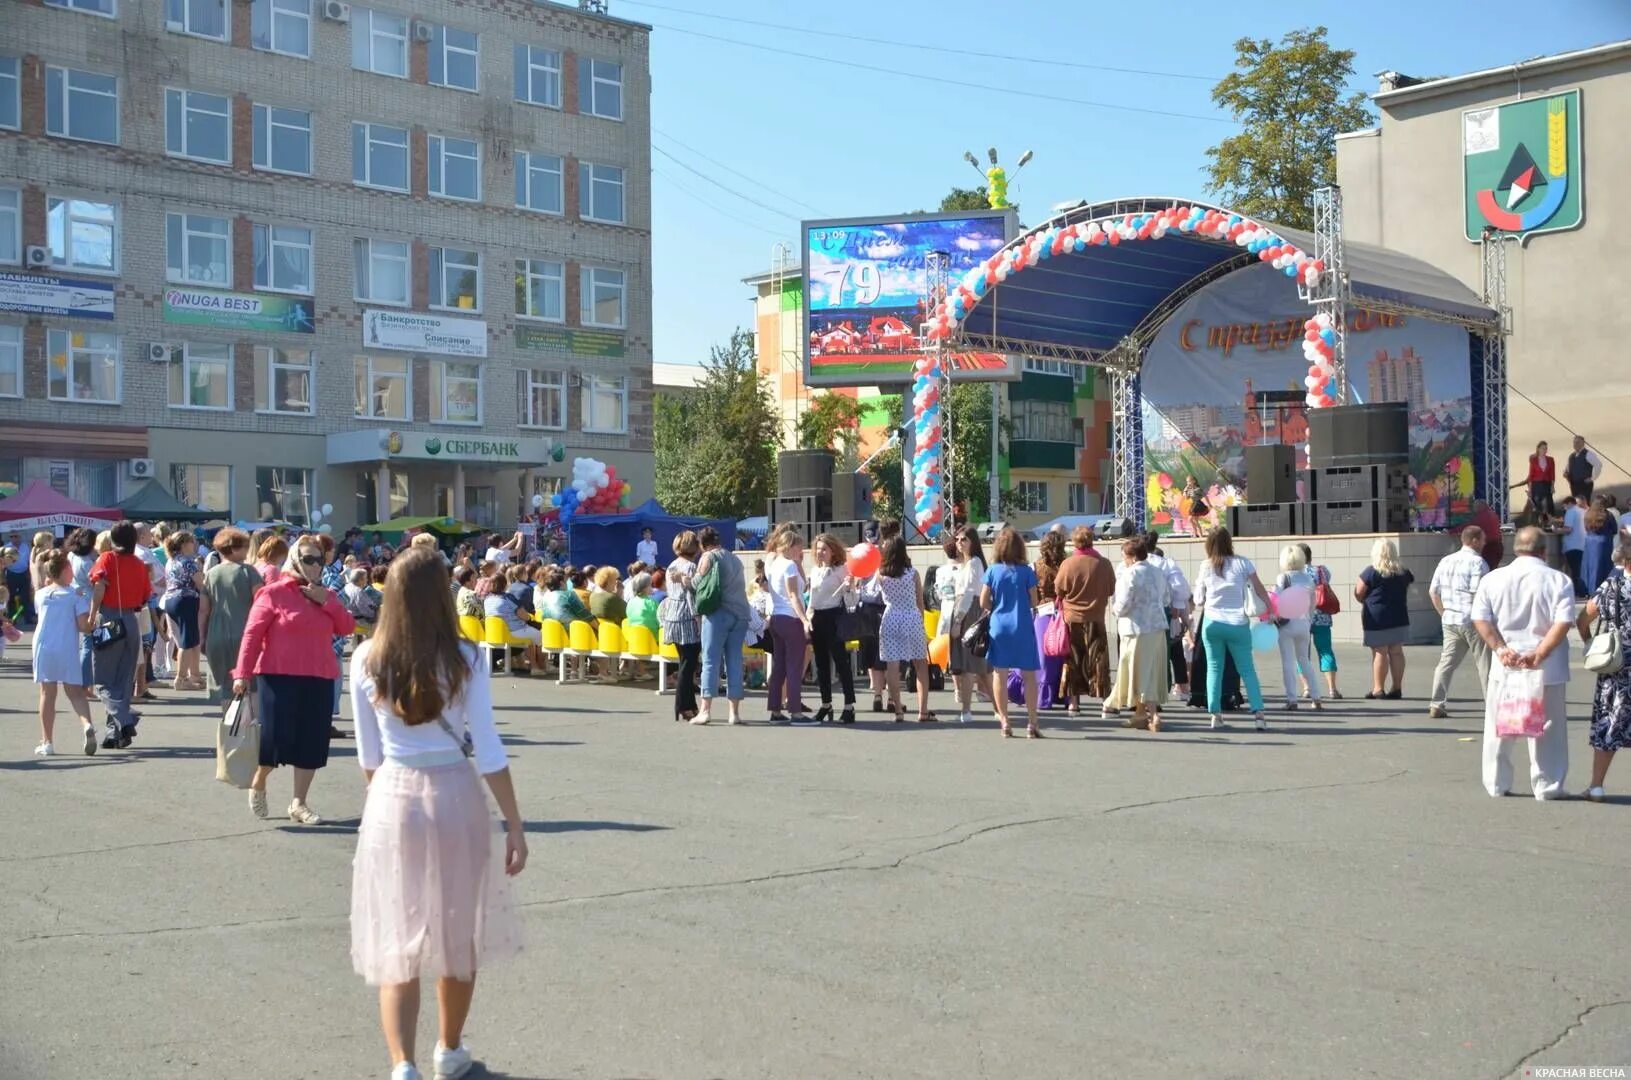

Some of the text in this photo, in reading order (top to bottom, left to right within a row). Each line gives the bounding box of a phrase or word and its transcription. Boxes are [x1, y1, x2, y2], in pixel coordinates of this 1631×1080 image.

[813, 231, 845, 240] 13:09
[823, 262, 882, 306] 79
[181, 294, 260, 311] NUGA BEST
[380, 313, 441, 327] Банкротство
[424, 333, 471, 345] Списание
[1180, 319, 1203, 351] С
[446, 439, 519, 456] СБЕРБАНК
